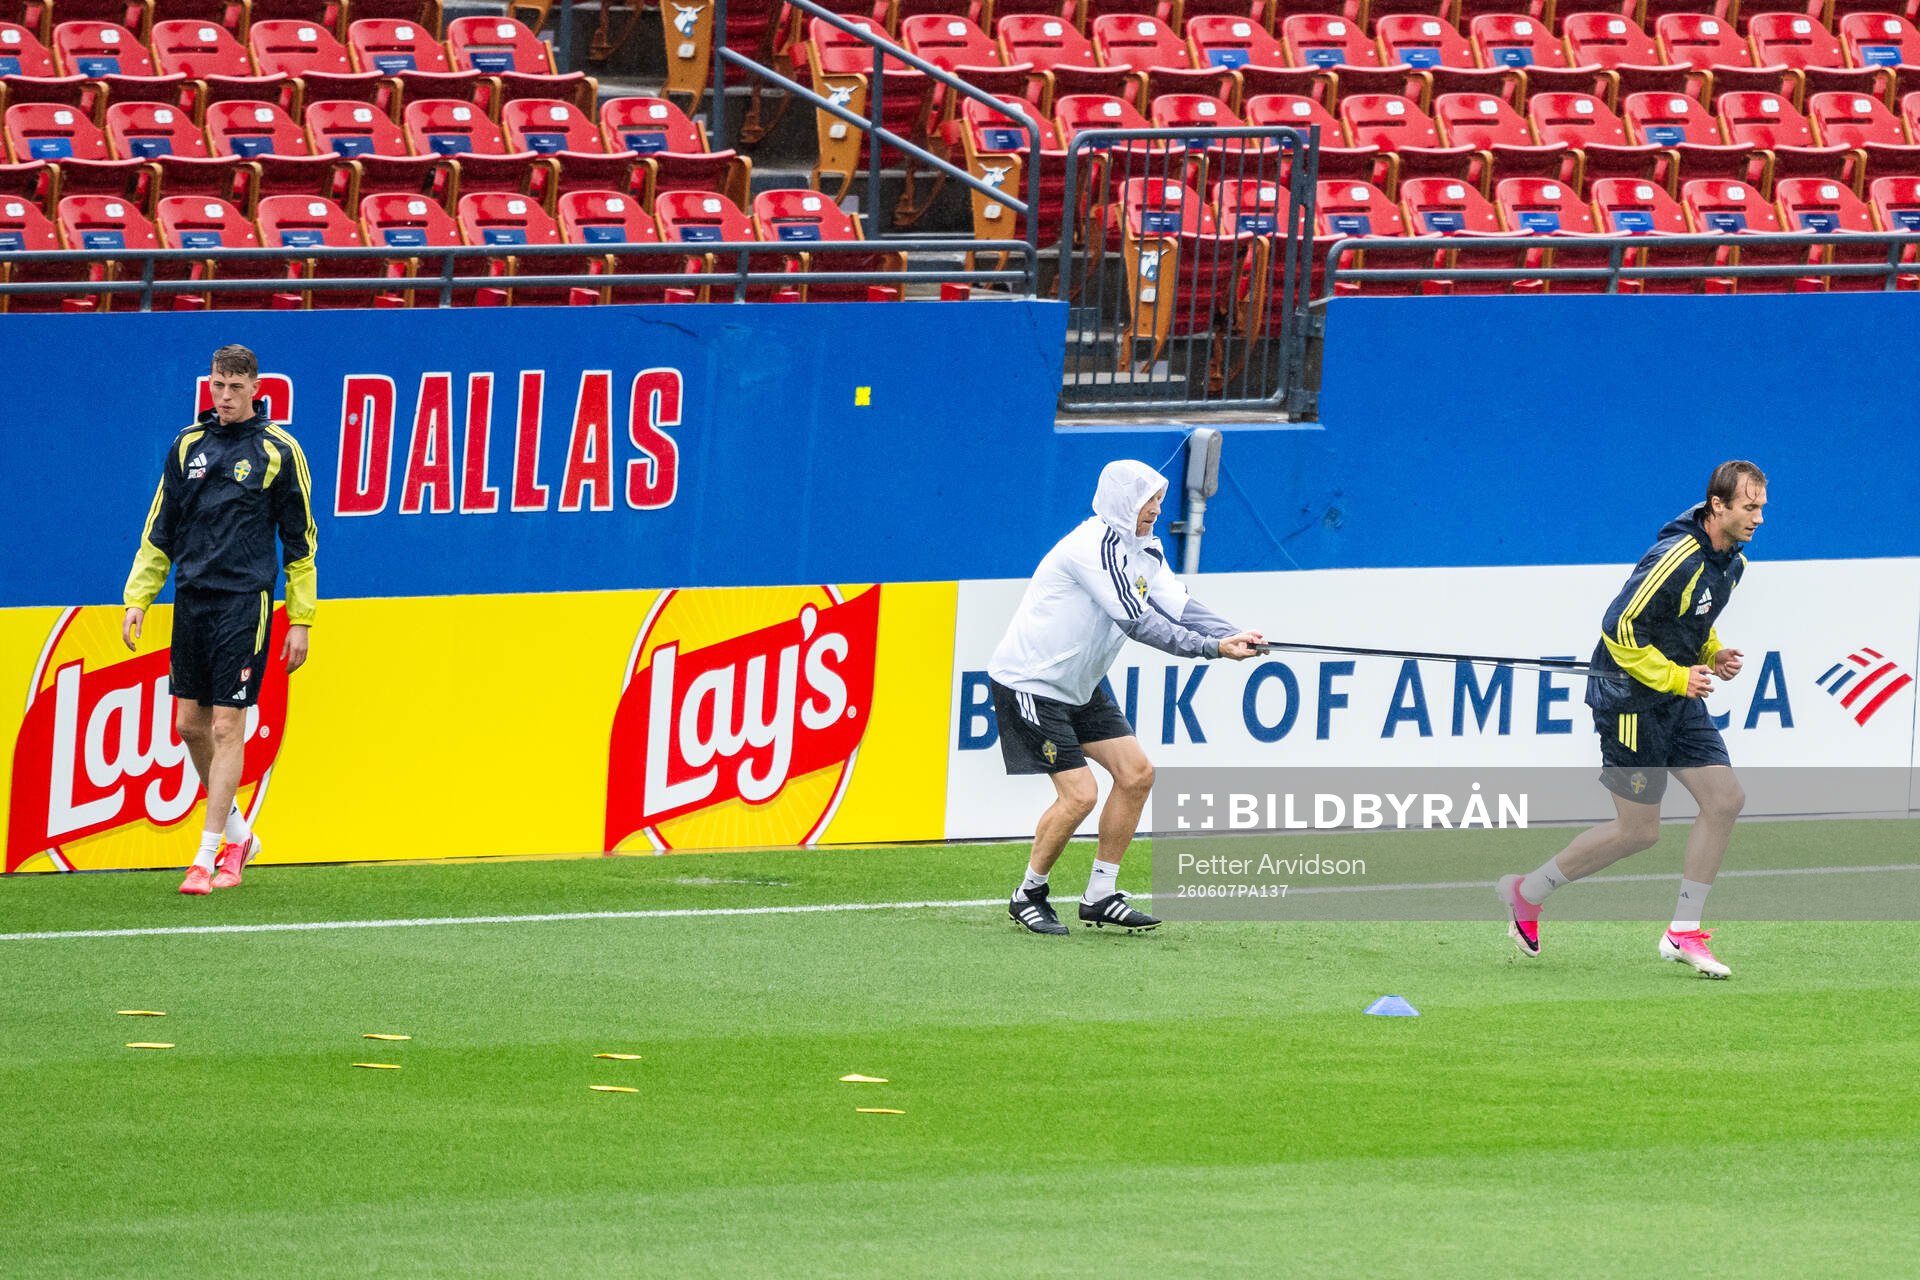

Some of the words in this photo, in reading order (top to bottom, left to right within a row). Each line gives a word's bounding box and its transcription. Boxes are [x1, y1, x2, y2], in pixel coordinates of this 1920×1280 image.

[334, 367, 683, 517] DALLAS
[1242, 661, 1356, 744] OF
[1380, 651, 1795, 738] AMEA
